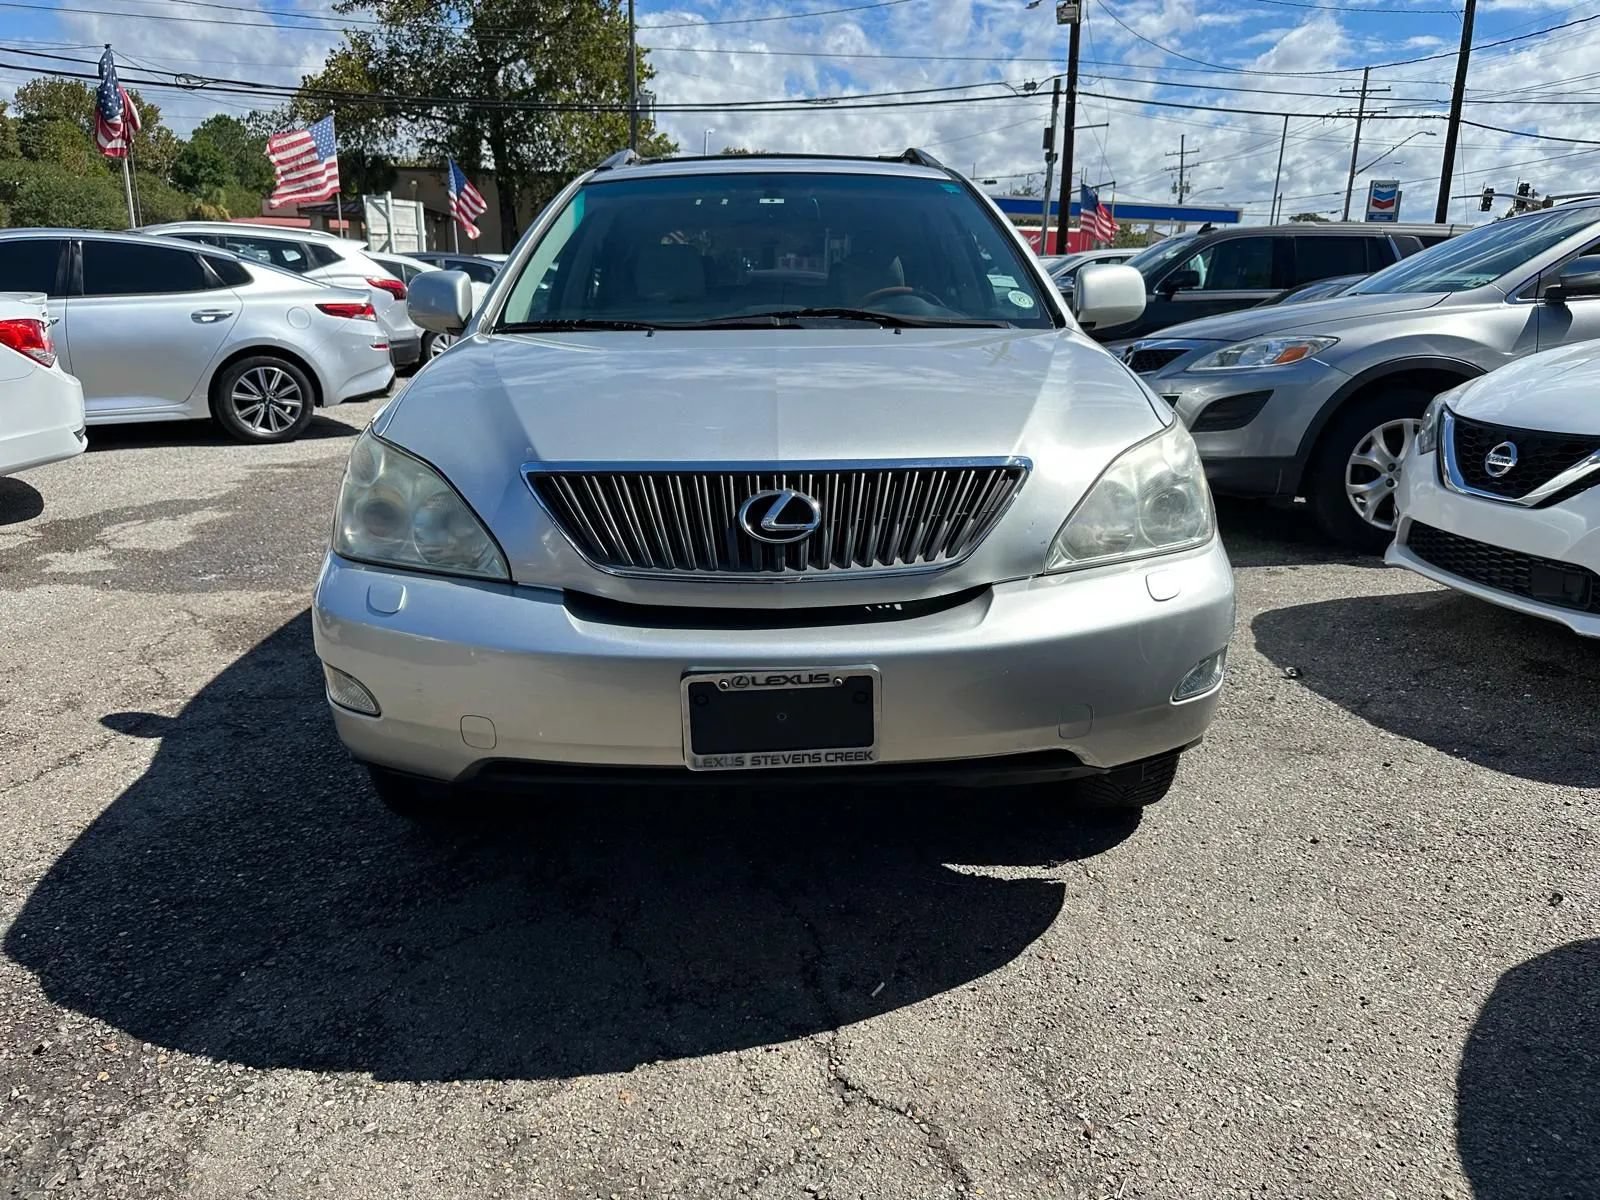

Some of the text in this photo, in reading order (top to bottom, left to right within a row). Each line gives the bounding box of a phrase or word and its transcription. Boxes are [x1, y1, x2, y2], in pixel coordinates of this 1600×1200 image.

[751, 674, 830, 686] LEXUS
[694, 750, 873, 768] LEXUS STEVENS CREEK
